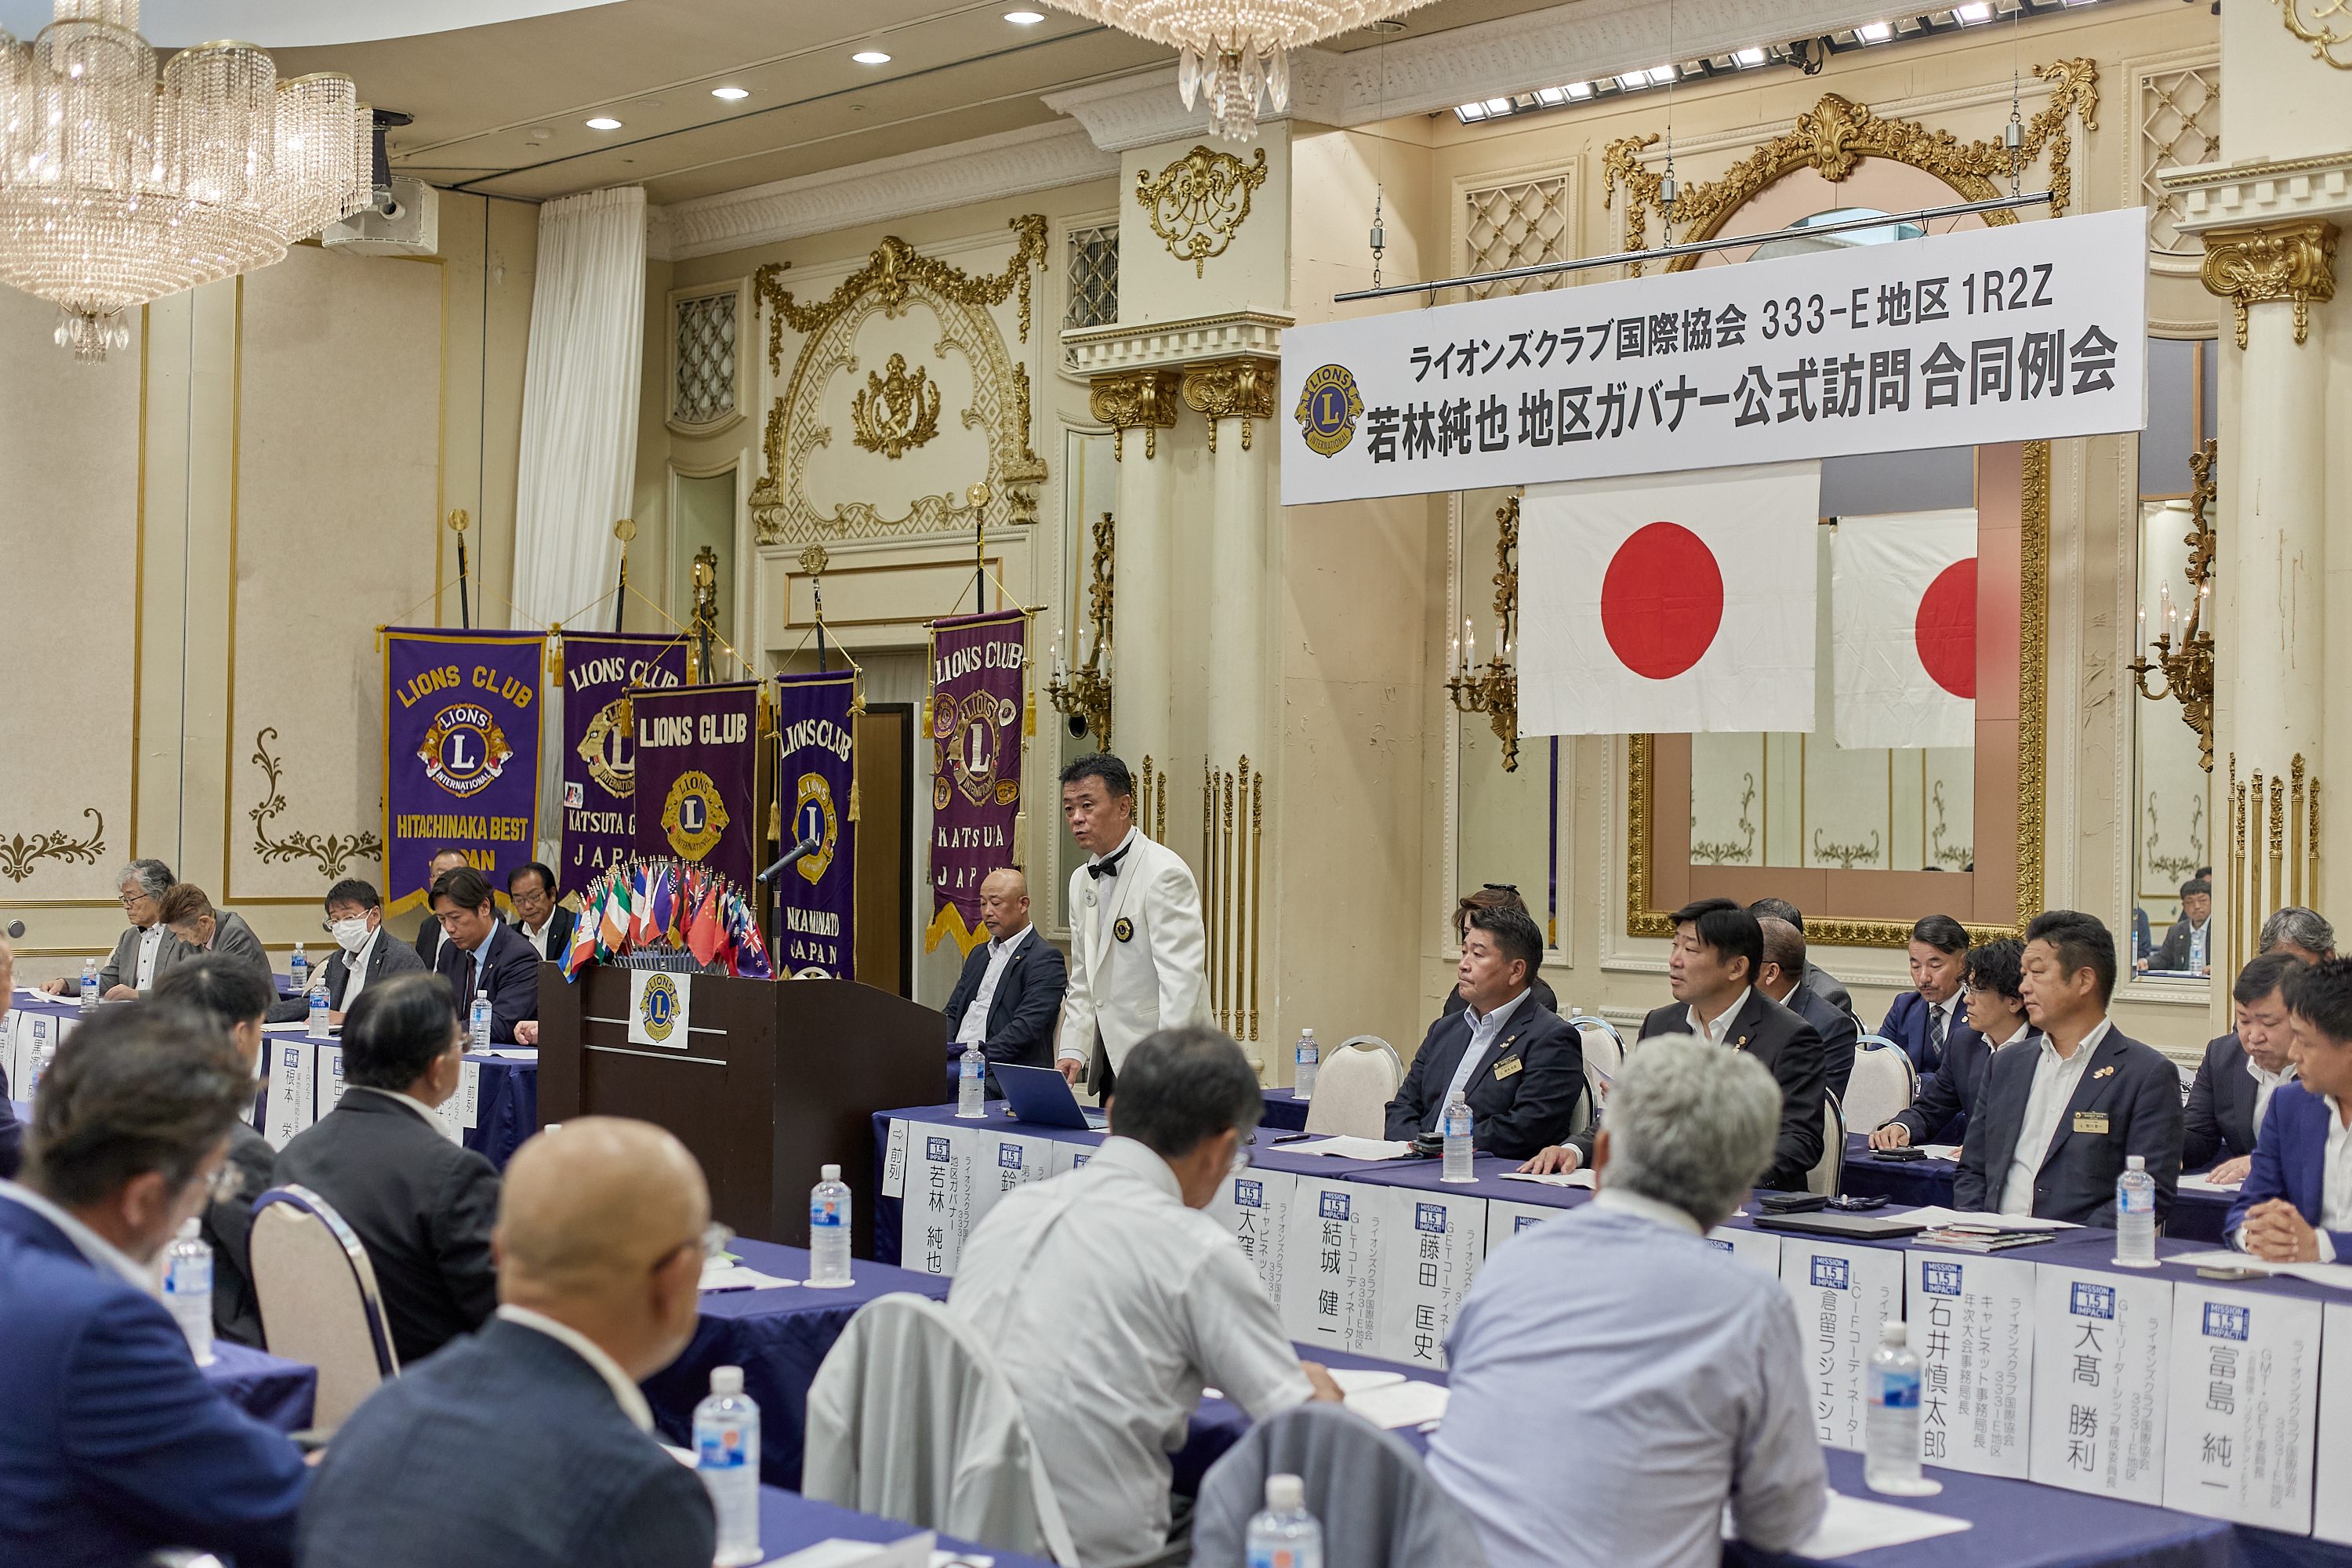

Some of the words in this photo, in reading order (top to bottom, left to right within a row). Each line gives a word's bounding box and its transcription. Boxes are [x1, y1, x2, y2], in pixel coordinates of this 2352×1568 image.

[1410, 303, 1747, 383] ライオンズクラブ国際協会
[1962, 263, 2053, 314] 1R2Z
[1310, 368, 1349, 389] LIONS
[1322, 394, 1339, 425] L
[1310, 433, 1348, 450] INTERNATIONAL
[1367, 394, 1509, 463] 若林純也
[568, 656, 626, 692] LIONS
[935, 645, 982, 686] LIONS
[985, 641, 1022, 670] CLUB
[397, 665, 461, 708] LIONS
[472, 666, 534, 708] CLUB
[440, 709, 488, 728] LIONS
[640, 716, 693, 747] LIONS
[699, 713, 747, 745] CLUB
[452, 735, 474, 768] L
[970, 724, 990, 771] L
[436, 771, 491, 790] INTERNATIONAL
[601, 770, 635, 792] INTERNATION
[679, 777, 710, 794] LIONS
[799, 779, 826, 800] LIONS
[397, 815, 488, 840] HITACHINAKA
[491, 817, 528, 841] BEST
[568, 809, 624, 835] KATSUTA
[684, 800, 702, 829] L
[938, 825, 1004, 848] KATSUA
[938, 866, 1003, 887] JAP
[649, 977, 673, 992] LIONS
[655, 995, 666, 1018] L
[648, 1025, 670, 1036] INTERNATIONAL
[285, 1069, 295, 1104] 根本
[466, 1085, 475, 1112] 前列
[889, 1147, 903, 1180] 前列
[934, 1145, 943, 1154] 1.5
[929, 1166, 946, 1213] 若林
[949, 1155, 959, 1230] 地区ガバナー
[1244, 1189, 1254, 1199] 1.5
[1330, 1201, 1340, 1211] 1.5
[1420, 1204, 1443, 1213] MISSION
[1426, 1213, 1436, 1223] 1.5
[927, 1226, 943, 1274] 純也
[1320, 1220, 1342, 1275] 結城
[1419, 1233, 1440, 1287] 藤田
[1816, 1257, 1844, 1267] MISSION
[1823, 1266, 1837, 1279] 1.5
[1928, 1262, 1957, 1272] MISSION
[1365, 1217, 1380, 1341] ライオンズクラブ国際協会
[1936, 1272, 1950, 1285] 1.5
[2078, 1283, 2109, 1295] MISSION
[1318, 1289, 1338, 1333] 健一
[2086, 1294, 2100, 1307] 1.5
[2210, 1304, 2244, 1316] MISSION
[1414, 1305, 1436, 1360] 匡史
[2218, 1314, 2234, 1329] 1.5
[1819, 1290, 1838, 1441] 倉留ラジェシュ
[1958, 1294, 1976, 1415] 年次大会事務局長
[1924, 1297, 1953, 1460] 石井慎太郎
[1973, 1296, 1994, 1449] キャビネット事務局長
[2003, 1298, 2021, 1446] ライオンズクラブ国際協会
[2206, 1345, 2239, 1415] 富島
[2067, 1403, 2098, 1472] 勝利
[2201, 1432, 2232, 1489] 純一
